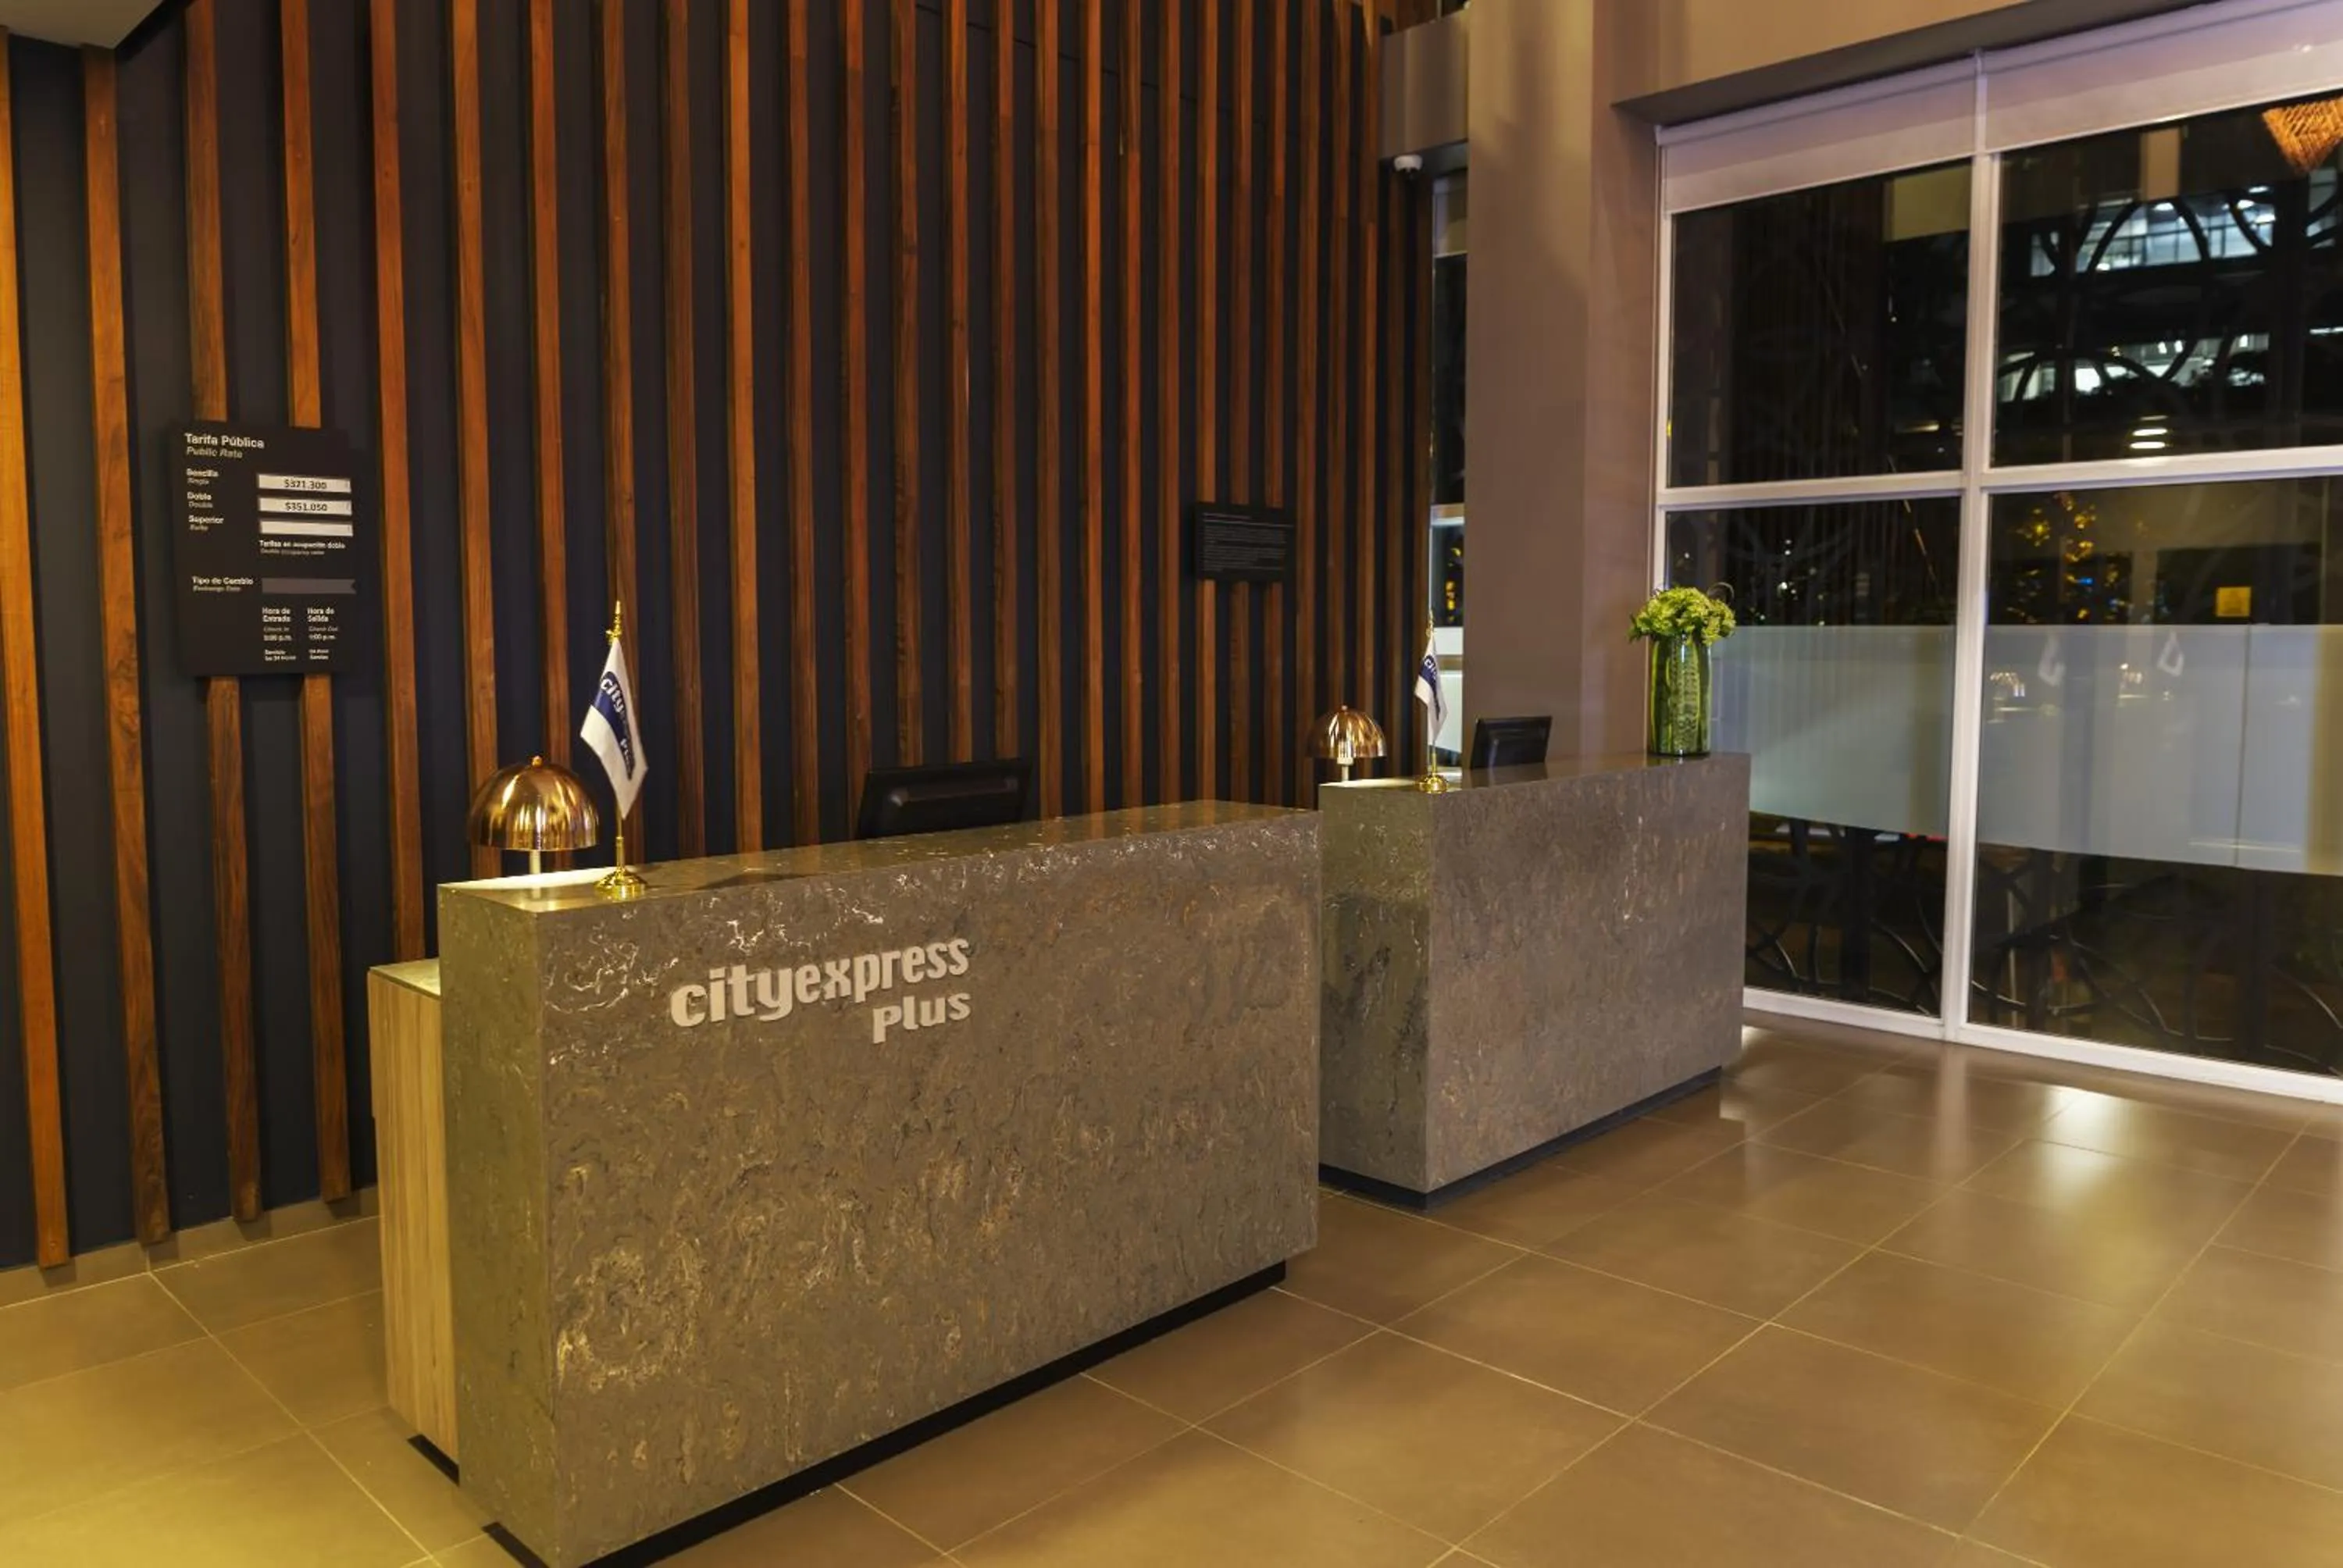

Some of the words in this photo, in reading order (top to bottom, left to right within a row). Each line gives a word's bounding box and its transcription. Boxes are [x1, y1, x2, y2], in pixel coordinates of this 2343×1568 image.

[184, 433, 218, 446] Tarifa
[220, 435, 266, 449] Pública
[188, 515, 224, 524] Superior
[670, 938, 969, 1028] cityexpress
[872, 992, 971, 1044] plus
